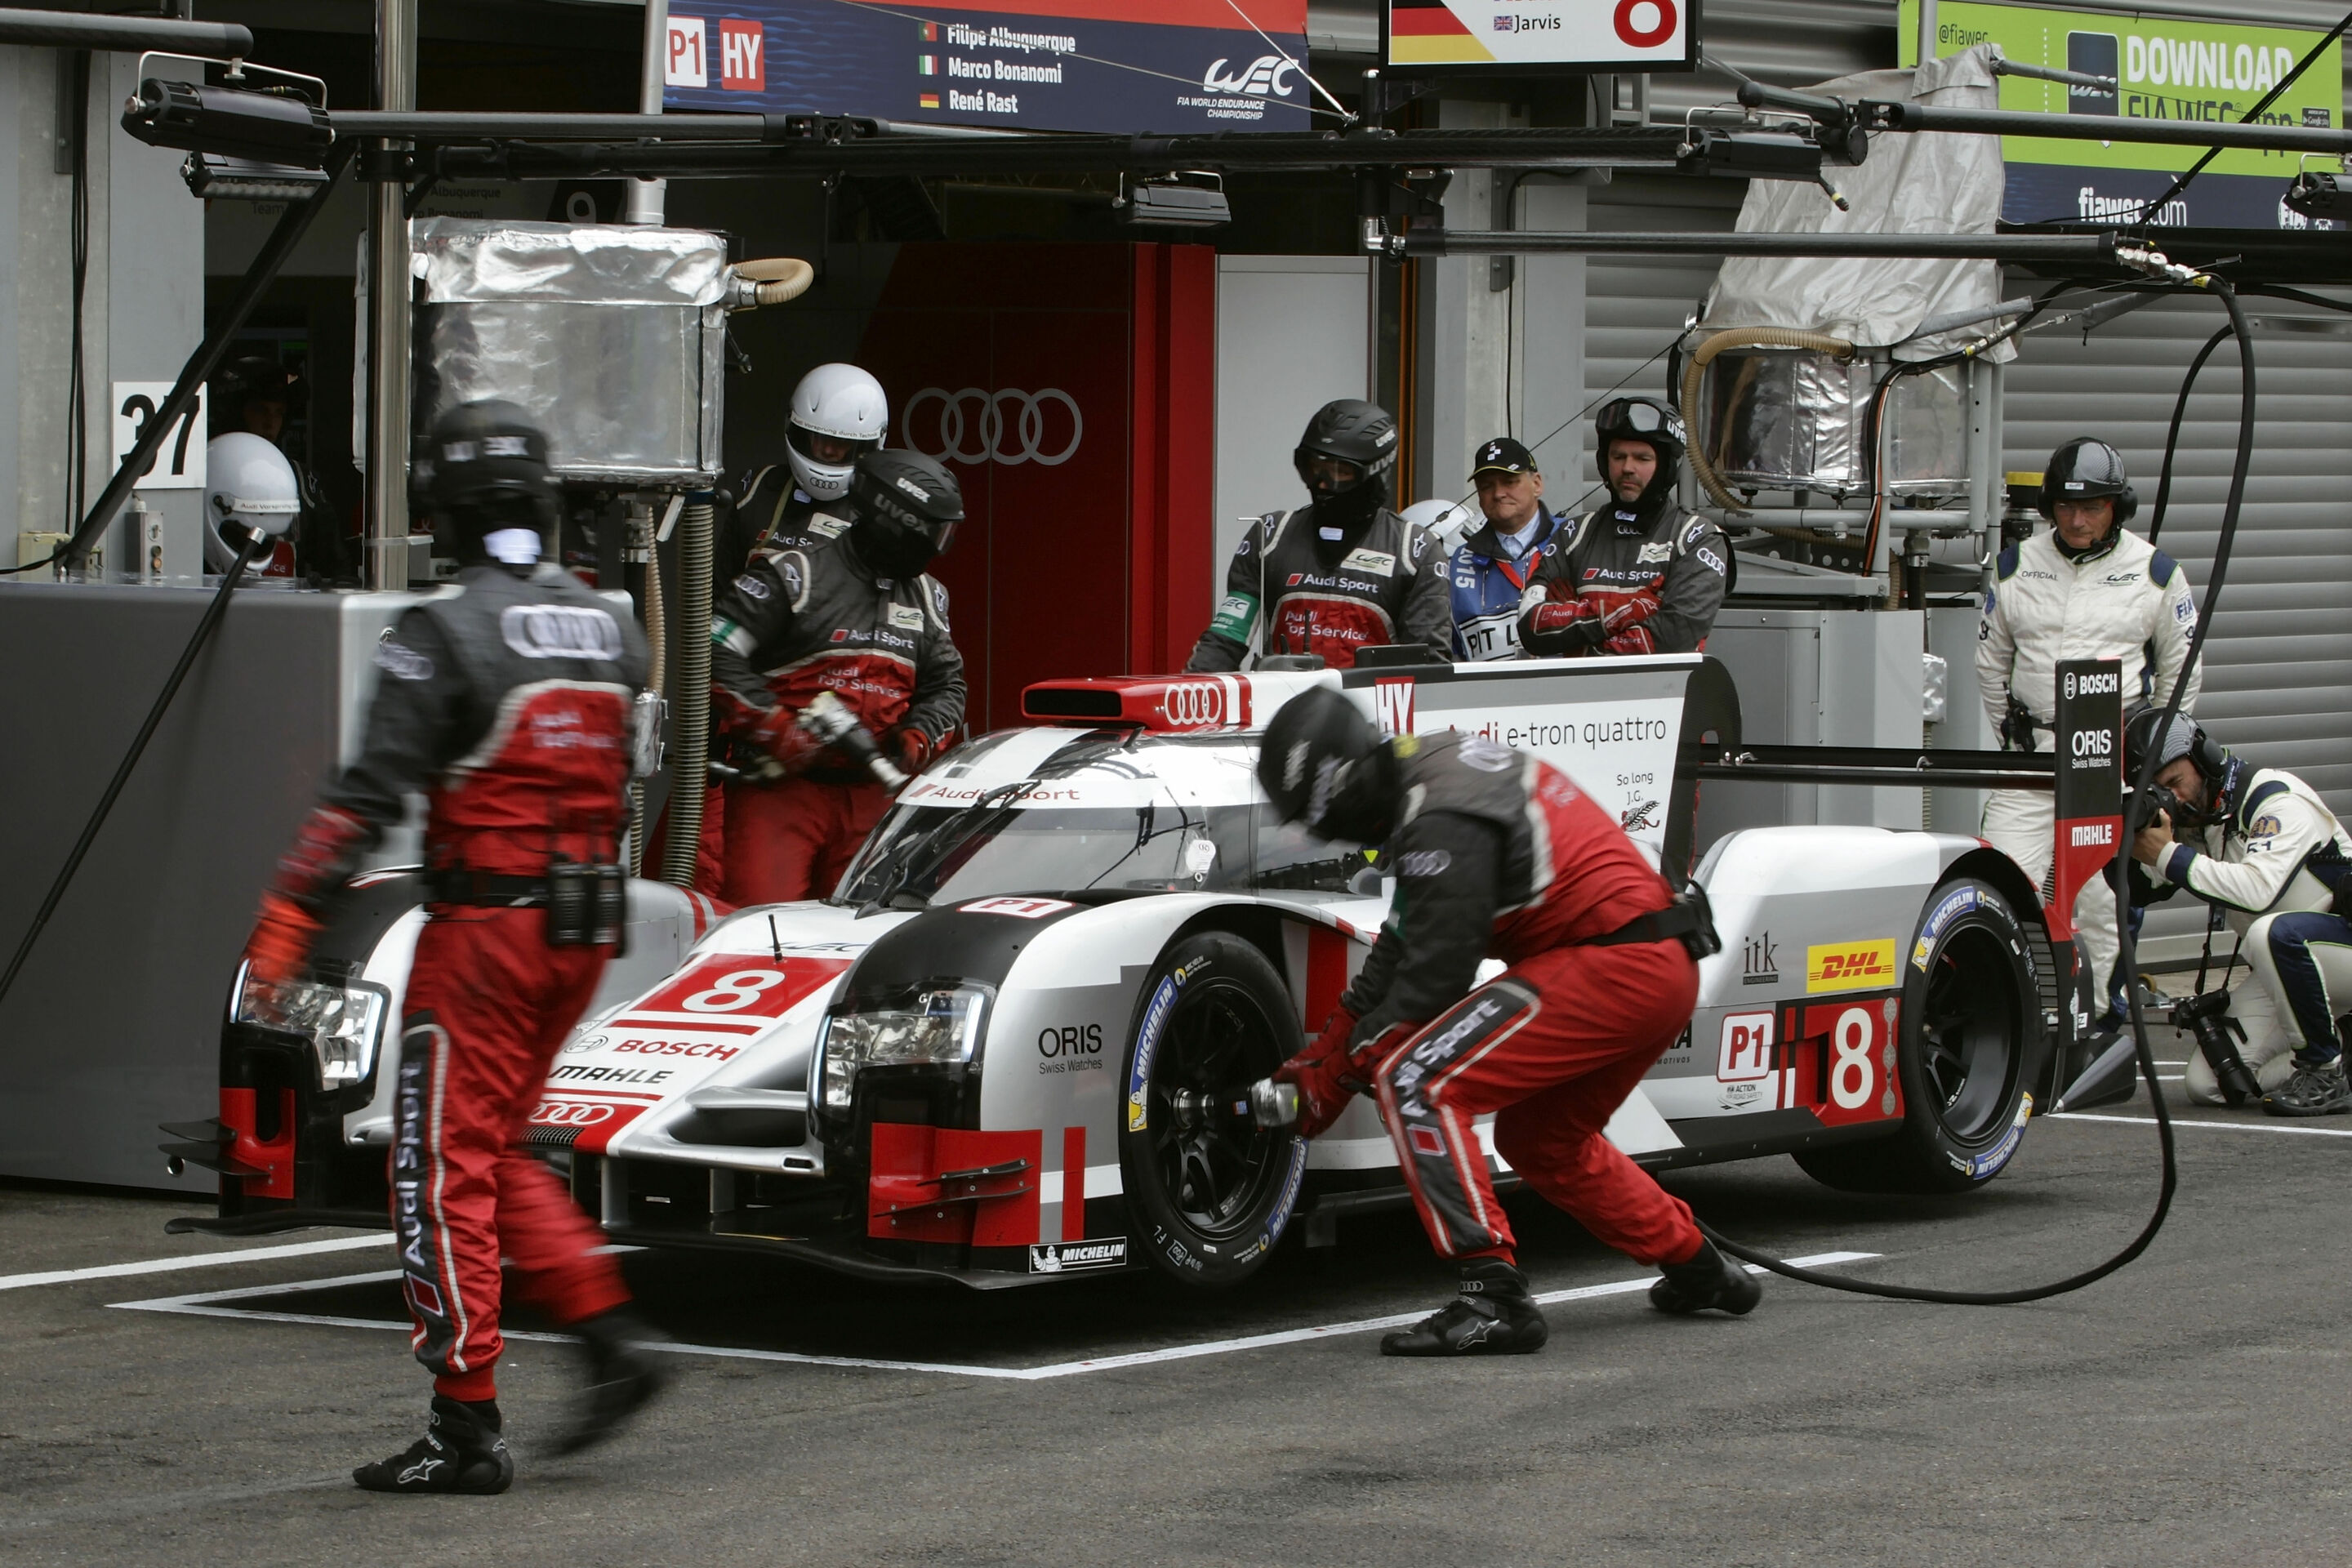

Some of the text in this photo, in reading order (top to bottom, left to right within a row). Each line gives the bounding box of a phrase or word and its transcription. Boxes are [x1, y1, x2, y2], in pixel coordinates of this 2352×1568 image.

[1515, 14, 1561, 33] Jarvis
[947, 24, 1076, 55] Filipe Albuquerque
[669, 29, 761, 79] P1 HY
[2127, 35, 2294, 93] DOWNLOAD
[948, 57, 1062, 83] Marco Bonanomi
[1204, 56, 1298, 96] WEC
[949, 89, 1018, 113] René Rast
[1177, 97, 1265, 110] FIA WORLD ENDURANCE
[1207, 109, 1263, 121] CHAMPIONSHIP
[430, 186, 501, 198] Albuquerque
[120, 394, 200, 478] 37
[804, 422, 837, 435] Vorsprung
[1667, 419, 1687, 447] uve
[897, 477, 931, 503] uvex
[874, 493, 929, 536] uvex
[1356, 554, 1393, 567] WEC
[1303, 573, 1379, 594] Audi Sport
[2021, 570, 2058, 581] OFFICIAL
[2106, 573, 2141, 582] WEC
[1552, 609, 1574, 617] Audi
[2176, 599, 2194, 619] FIA
[849, 629, 915, 648] Audi Sport
[1311, 624, 1370, 641] Service
[1467, 627, 1495, 658] PIT
[817, 675, 846, 689] Top
[826, 666, 860, 677] udi
[2079, 673, 2118, 695] BOSCH
[1375, 683, 1413, 735] HY
[1507, 722, 1576, 748] e-tron
[1584, 716, 1666, 751] quattro
[2071, 729, 2112, 756] ORIS
[2071, 756, 2112, 769] Swiss Watches
[1616, 771, 1654, 787] So long
[1627, 791, 1644, 805] J.G.
[2071, 824, 2113, 847] MAHLE
[982, 899, 1054, 913] P1
[1930, 891, 1974, 934] MICHELIN
[1744, 929, 1780, 974] itk
[1184, 955, 1205, 972] MICHELIN
[1821, 951, 1882, 980] DHL
[683, 969, 786, 1013] 8
[1038, 1024, 1102, 1058] ORIS
[1136, 983, 1174, 1079] MICHELIN
[1414, 998, 1503, 1066] Sport
[612, 1040, 741, 1062] BOSCH
[1727, 1023, 1766, 1071] P1
[1831, 1007, 1874, 1109] 8
[549, 1065, 674, 1084] MAHLE
[1038, 1058, 1103, 1075] Swiss Watches
[1735, 1084, 1757, 1093] ACTION
[395, 1061, 426, 1267] Audi Sport
[1976, 1130, 2020, 1175] MICHELIN
[1271, 1143, 1307, 1236] MICHELIN
[1062, 1243, 1125, 1262] MICHELIN
